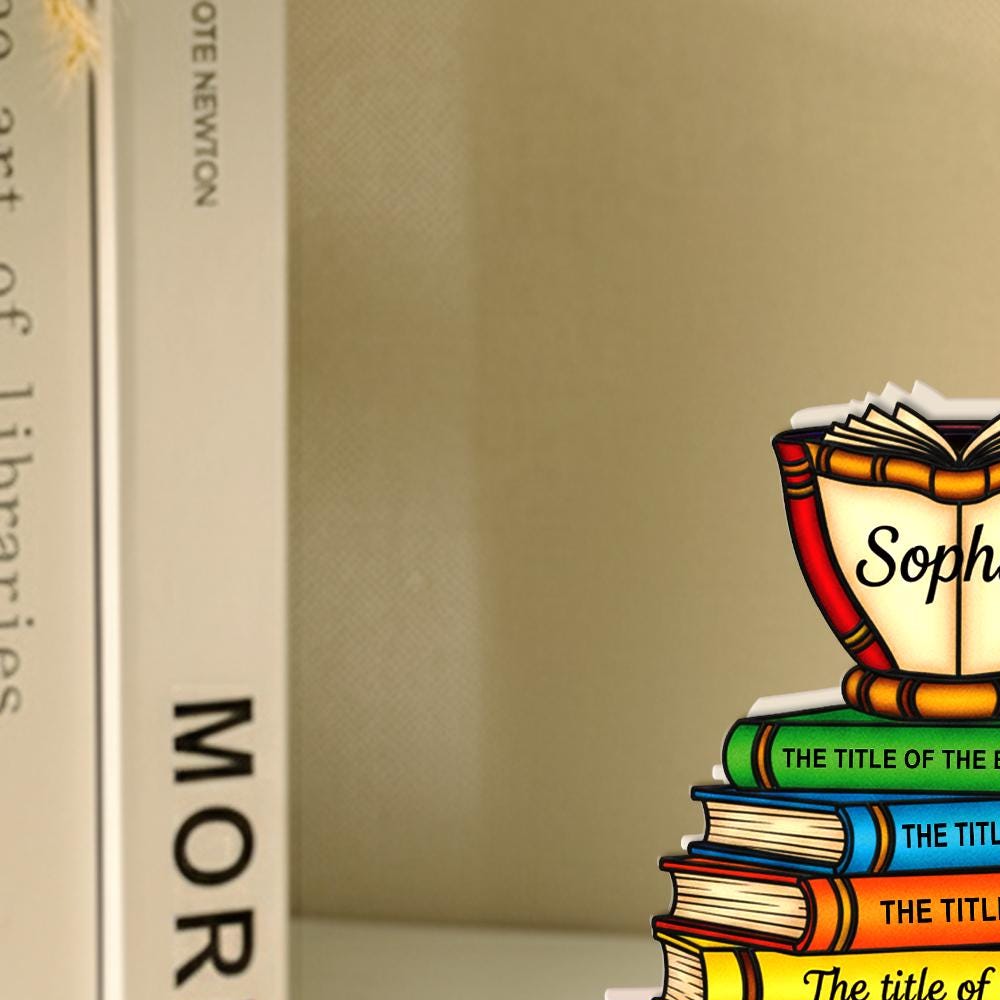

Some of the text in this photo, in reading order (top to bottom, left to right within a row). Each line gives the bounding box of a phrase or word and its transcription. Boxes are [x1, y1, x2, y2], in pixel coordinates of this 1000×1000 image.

[192, 71, 220, 208] NEWTON
[782, 747, 827, 769] THE
[833, 747, 897, 770] TITLE
[904, 748, 935, 770] OF
[941, 749, 986, 770] THE
[902, 823, 948, 849] THE
[880, 898, 933, 925] THE
